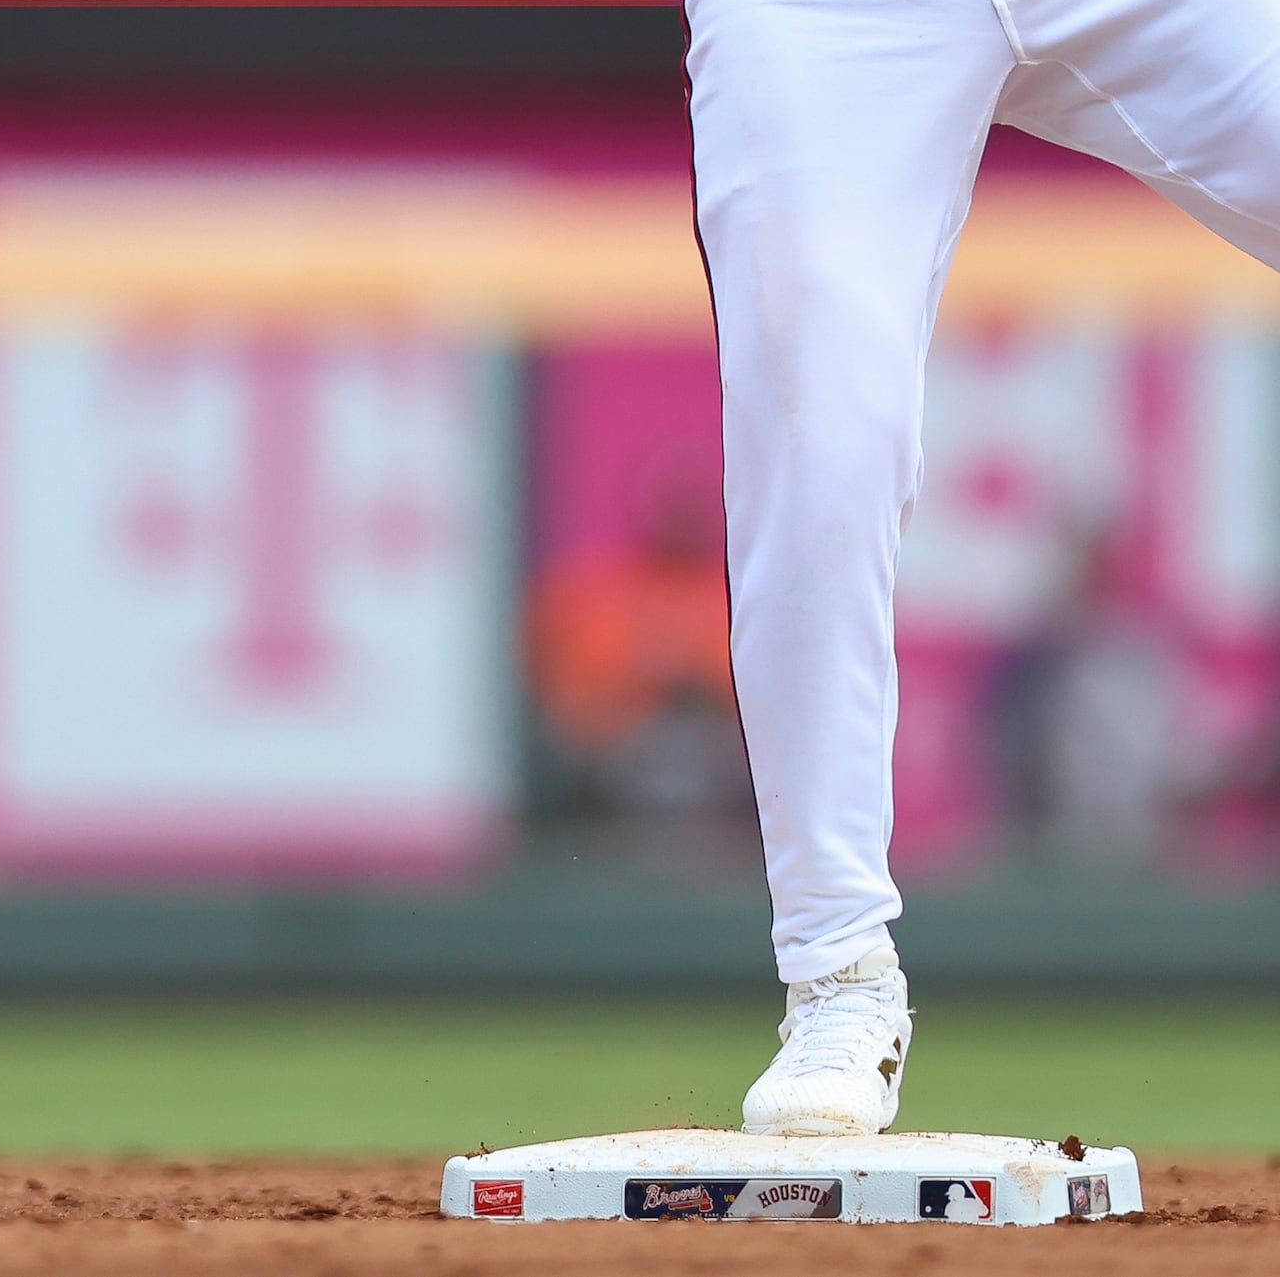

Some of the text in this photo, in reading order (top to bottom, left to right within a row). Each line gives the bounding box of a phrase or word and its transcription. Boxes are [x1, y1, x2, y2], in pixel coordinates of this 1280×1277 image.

[478, 1188, 518, 1204] Rawlings
[643, 1183, 702, 1210] Braves
[757, 1184, 833, 1209] HOUSTON
